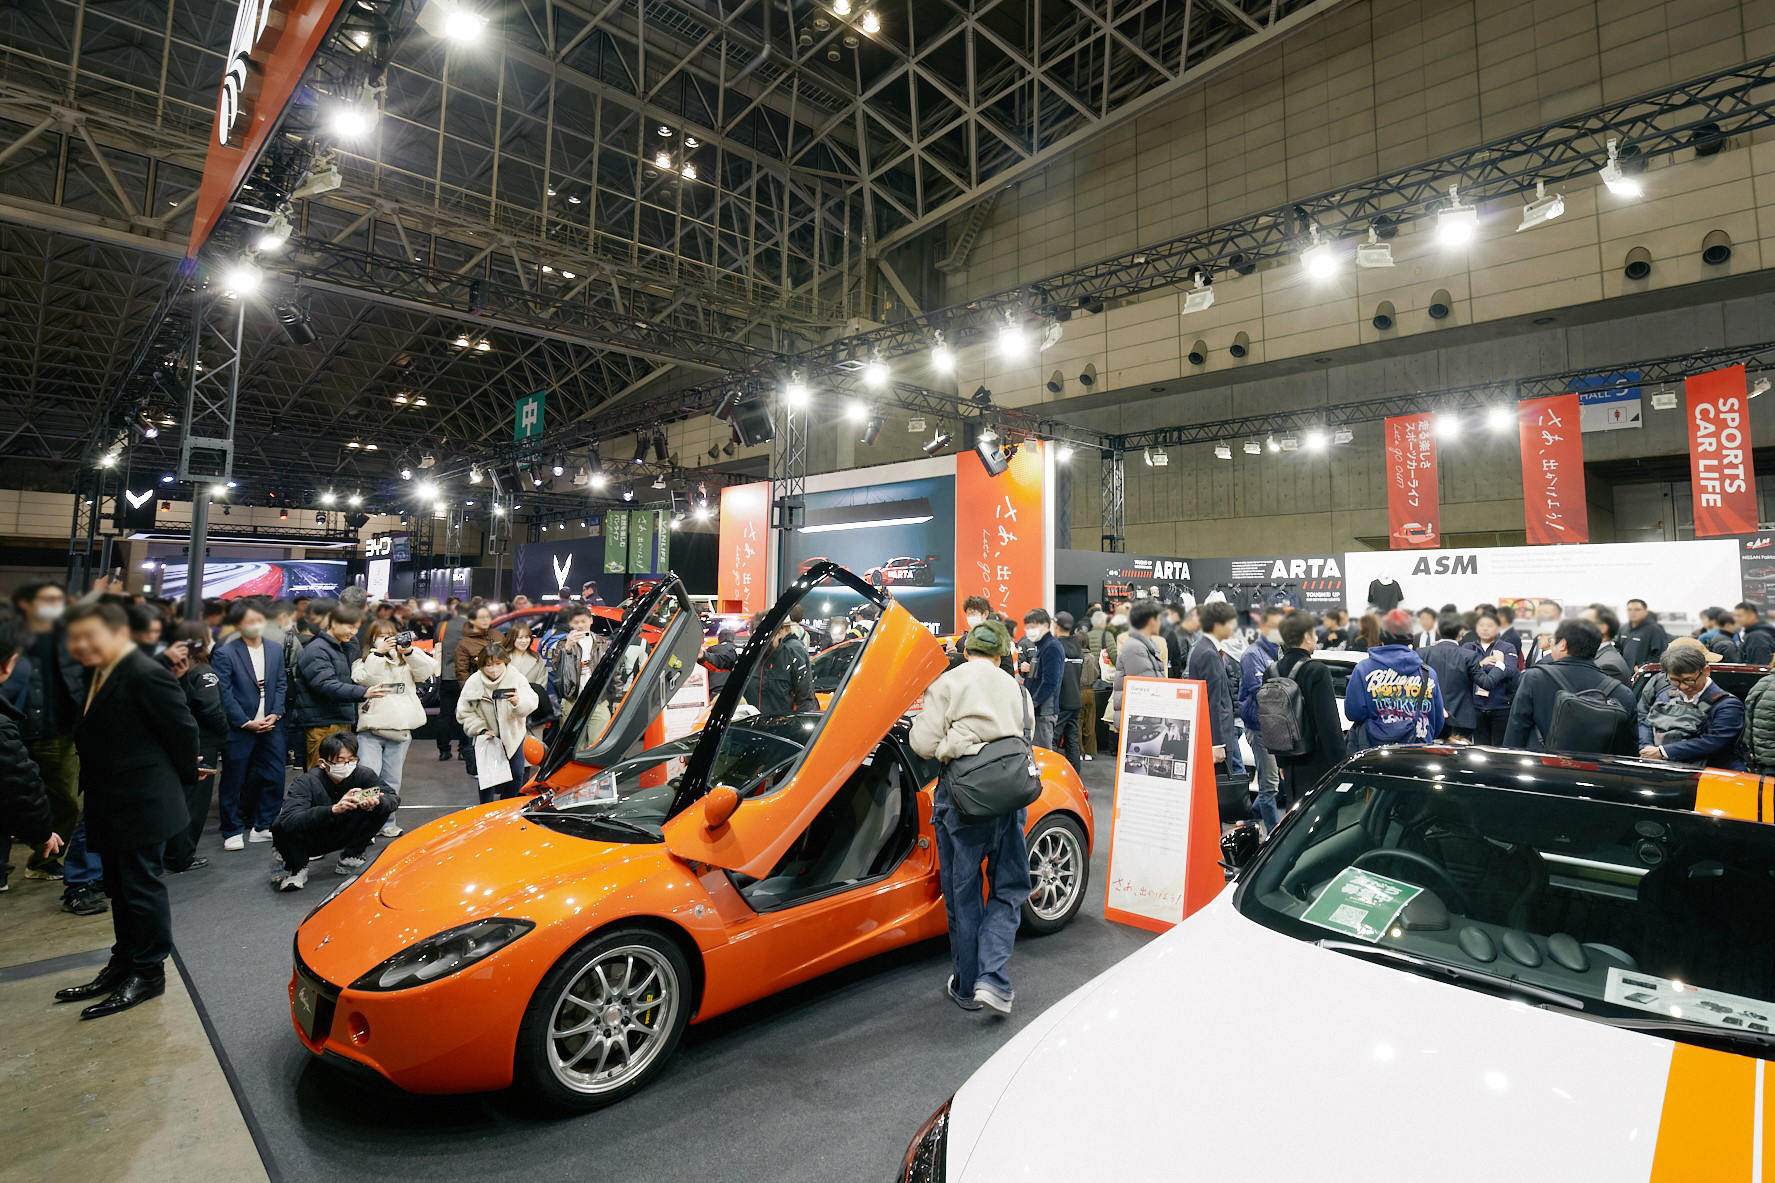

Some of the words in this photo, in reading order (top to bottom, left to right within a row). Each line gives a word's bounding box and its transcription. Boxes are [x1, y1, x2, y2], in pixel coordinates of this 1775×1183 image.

[521, 397, 538, 437] 中
[1695, 403, 1717, 453] CAR
[1405, 423, 1419, 507] スポーツカーライフ
[1418, 419, 1432, 469] 走る楽しさ
[1718, 397, 1746, 493] SPORTS
[1698, 459, 1722, 507] LIFE
[660, 520, 668, 563] VANLIFE
[1153, 560, 1191, 580] ARTA
[1270, 558, 1342, 579] ARTA
[1412, 555, 1478, 575] ASM
[1234, 627, 1262, 641] ART
